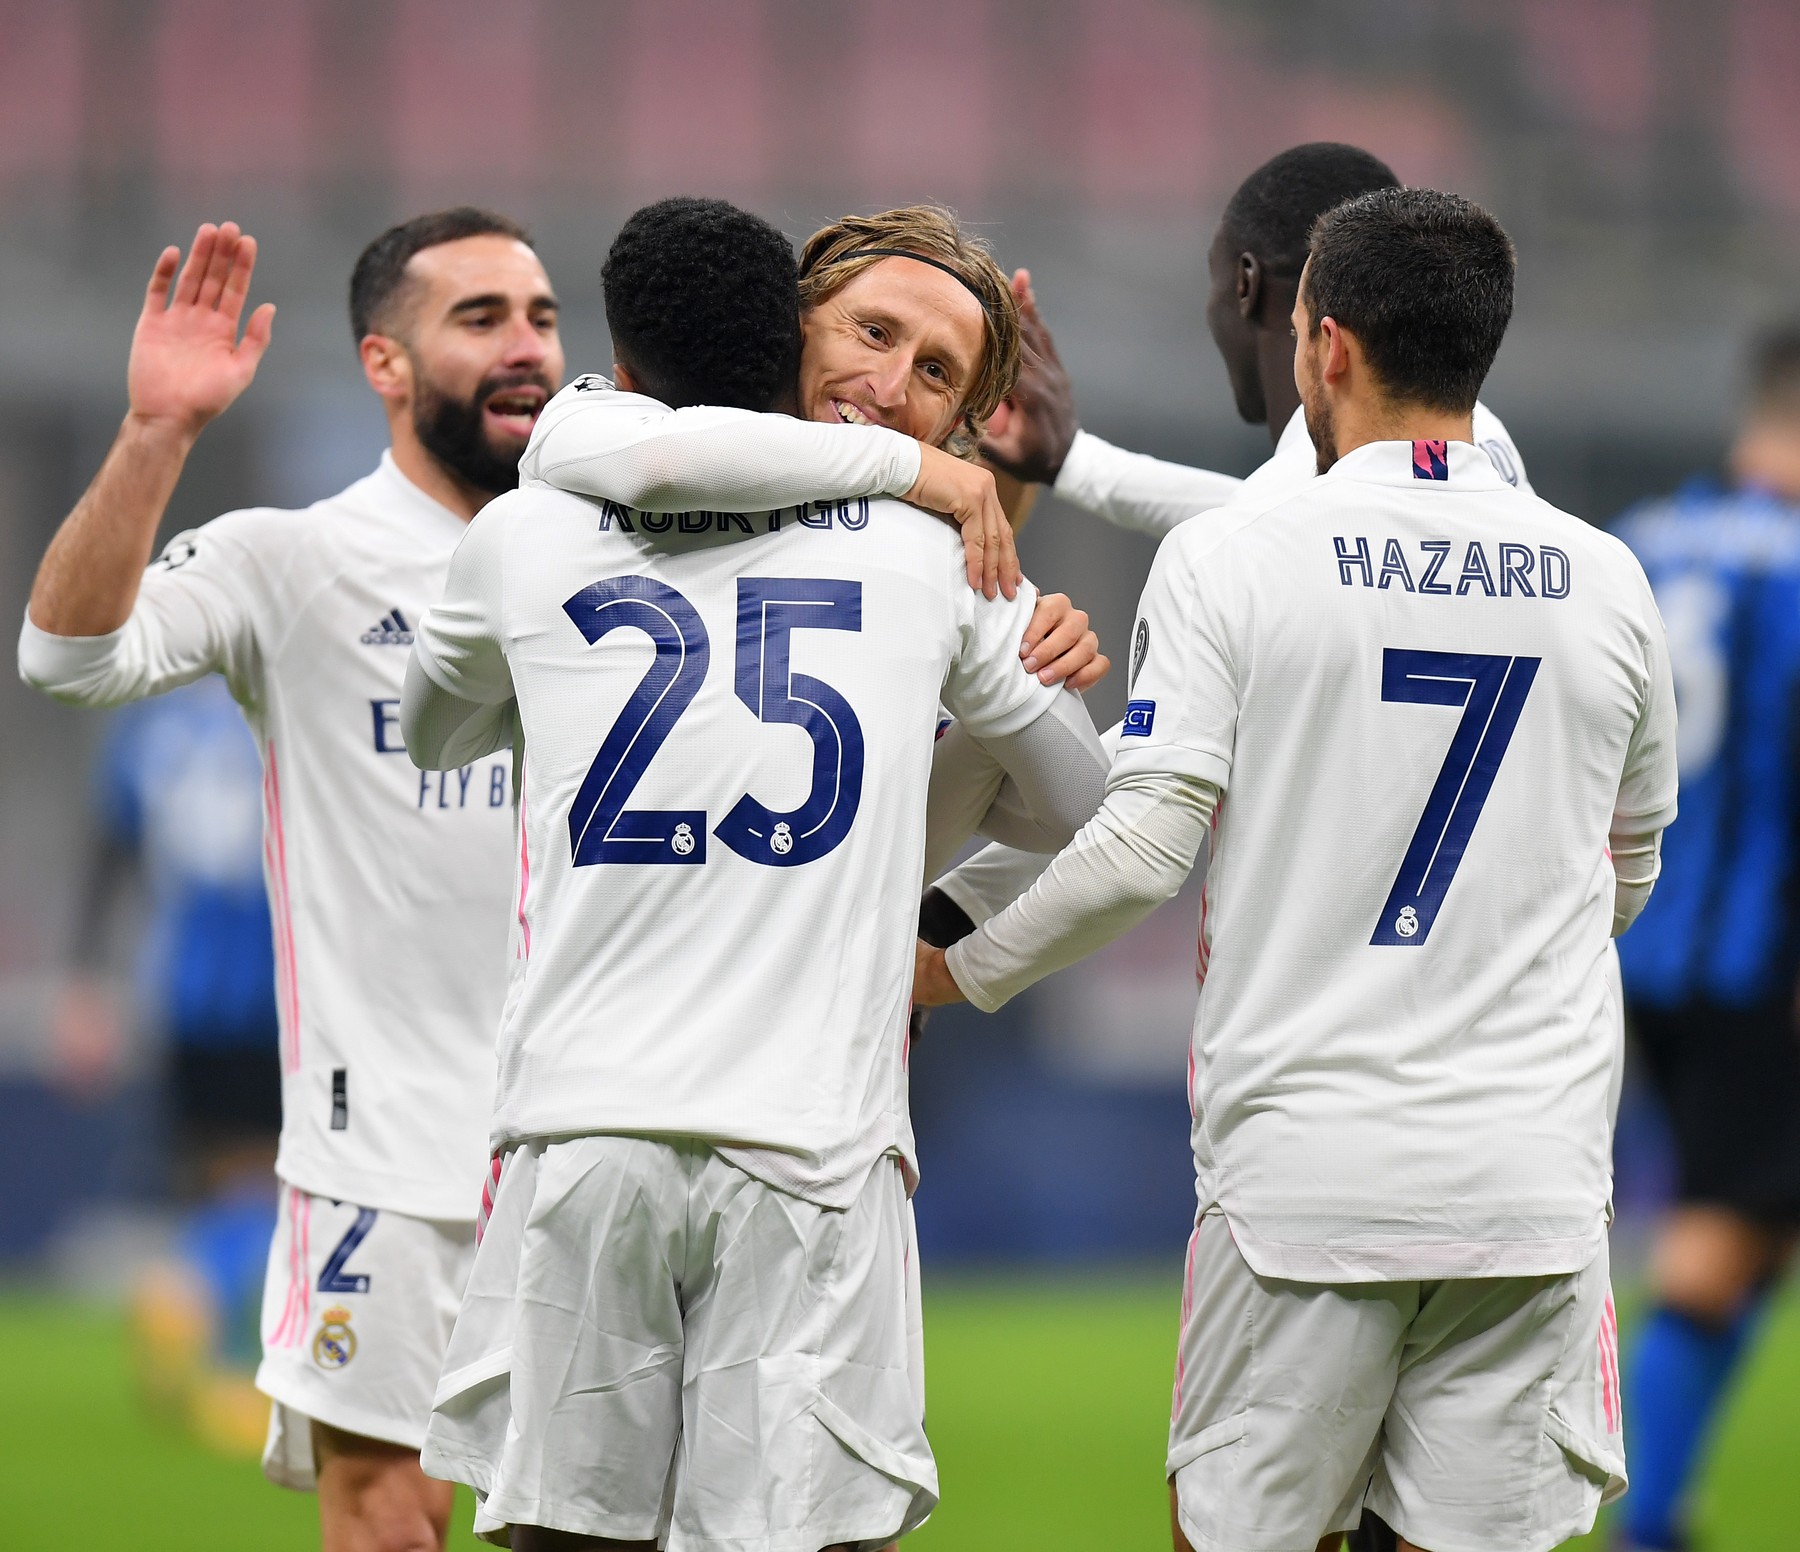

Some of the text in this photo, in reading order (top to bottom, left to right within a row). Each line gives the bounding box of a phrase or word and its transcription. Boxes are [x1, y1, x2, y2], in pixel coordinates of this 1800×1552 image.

[1333, 536, 1571, 600] HAZARD
[360, 631, 415, 645] adida
[562, 574, 865, 868] 25
[419, 766, 472, 809] FLY
[1369, 648, 1542, 946] 7
[317, 1199, 378, 1293] 2
